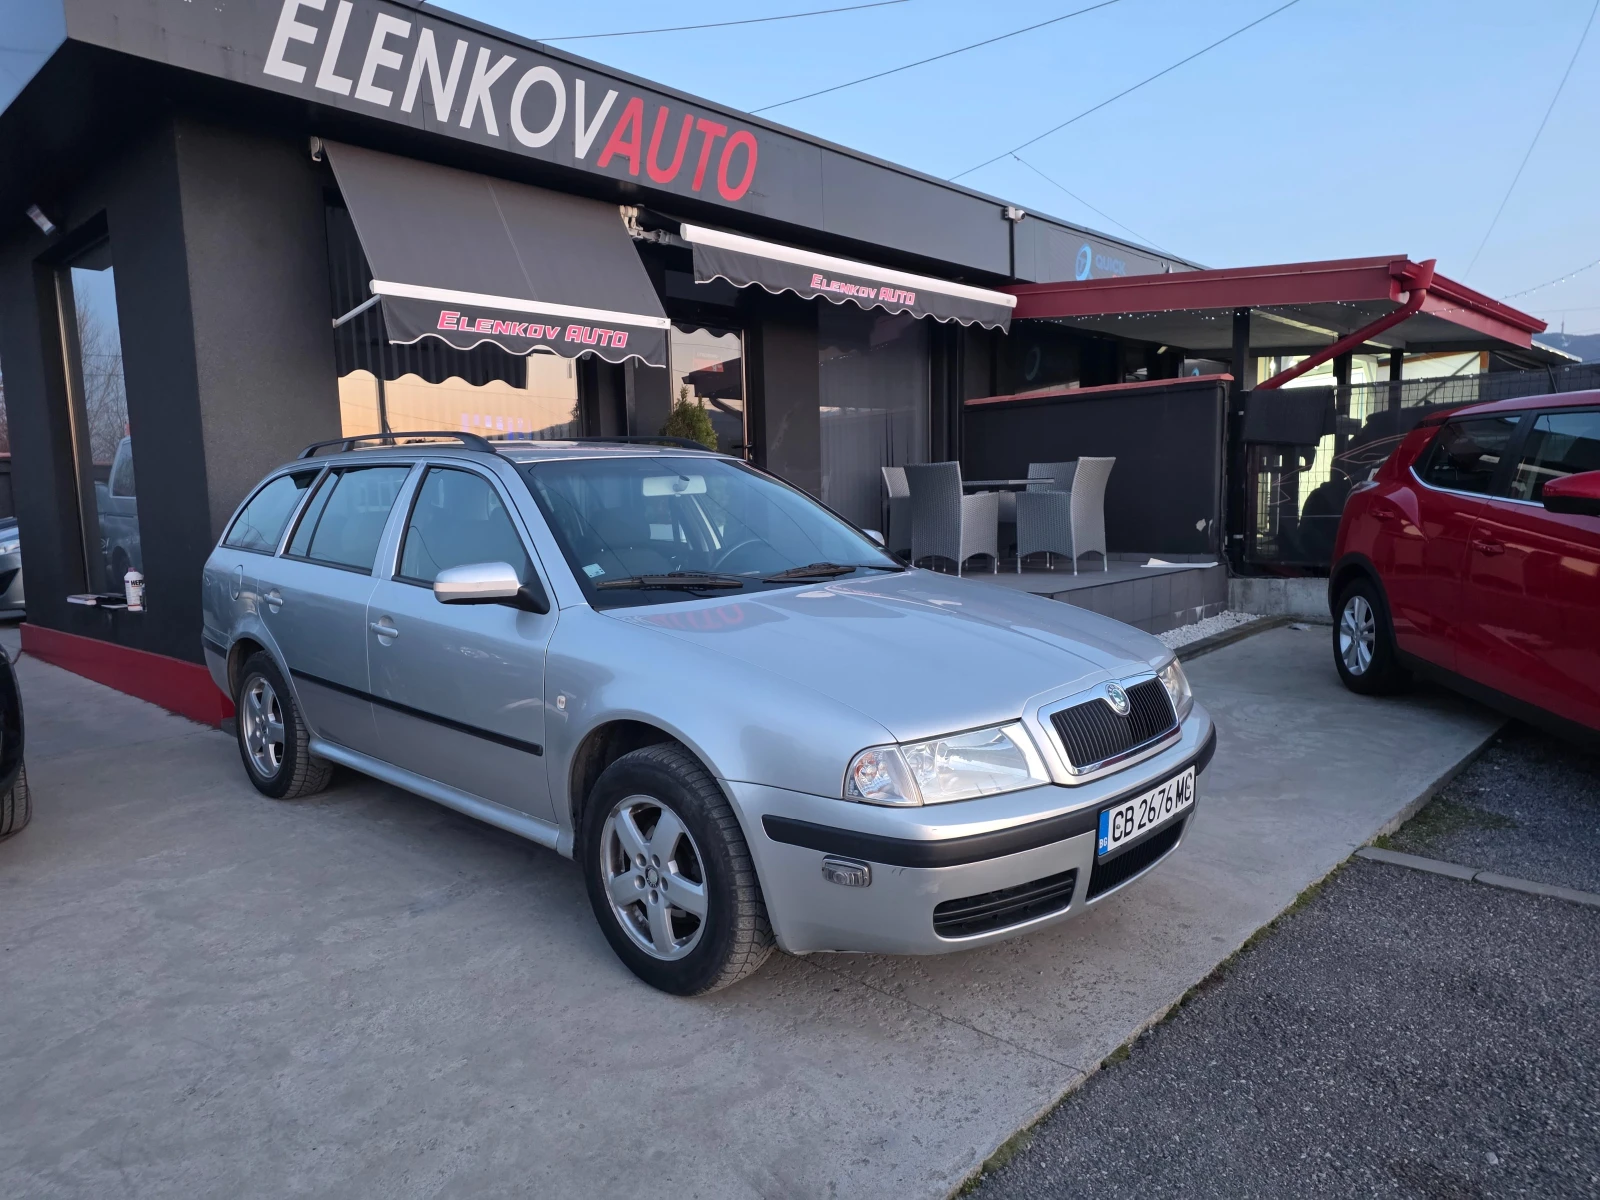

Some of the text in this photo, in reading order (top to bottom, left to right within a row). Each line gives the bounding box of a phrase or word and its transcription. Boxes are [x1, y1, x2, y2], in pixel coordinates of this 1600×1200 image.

[1095, 254, 1126, 276] QUICK
[810, 273, 916, 306] ELENKOV AUTO
[437, 310, 629, 348] ELENKOV AUTO
[1112, 772, 1192, 842] CB 2676 MC
[1099, 836, 1108, 849] BG
